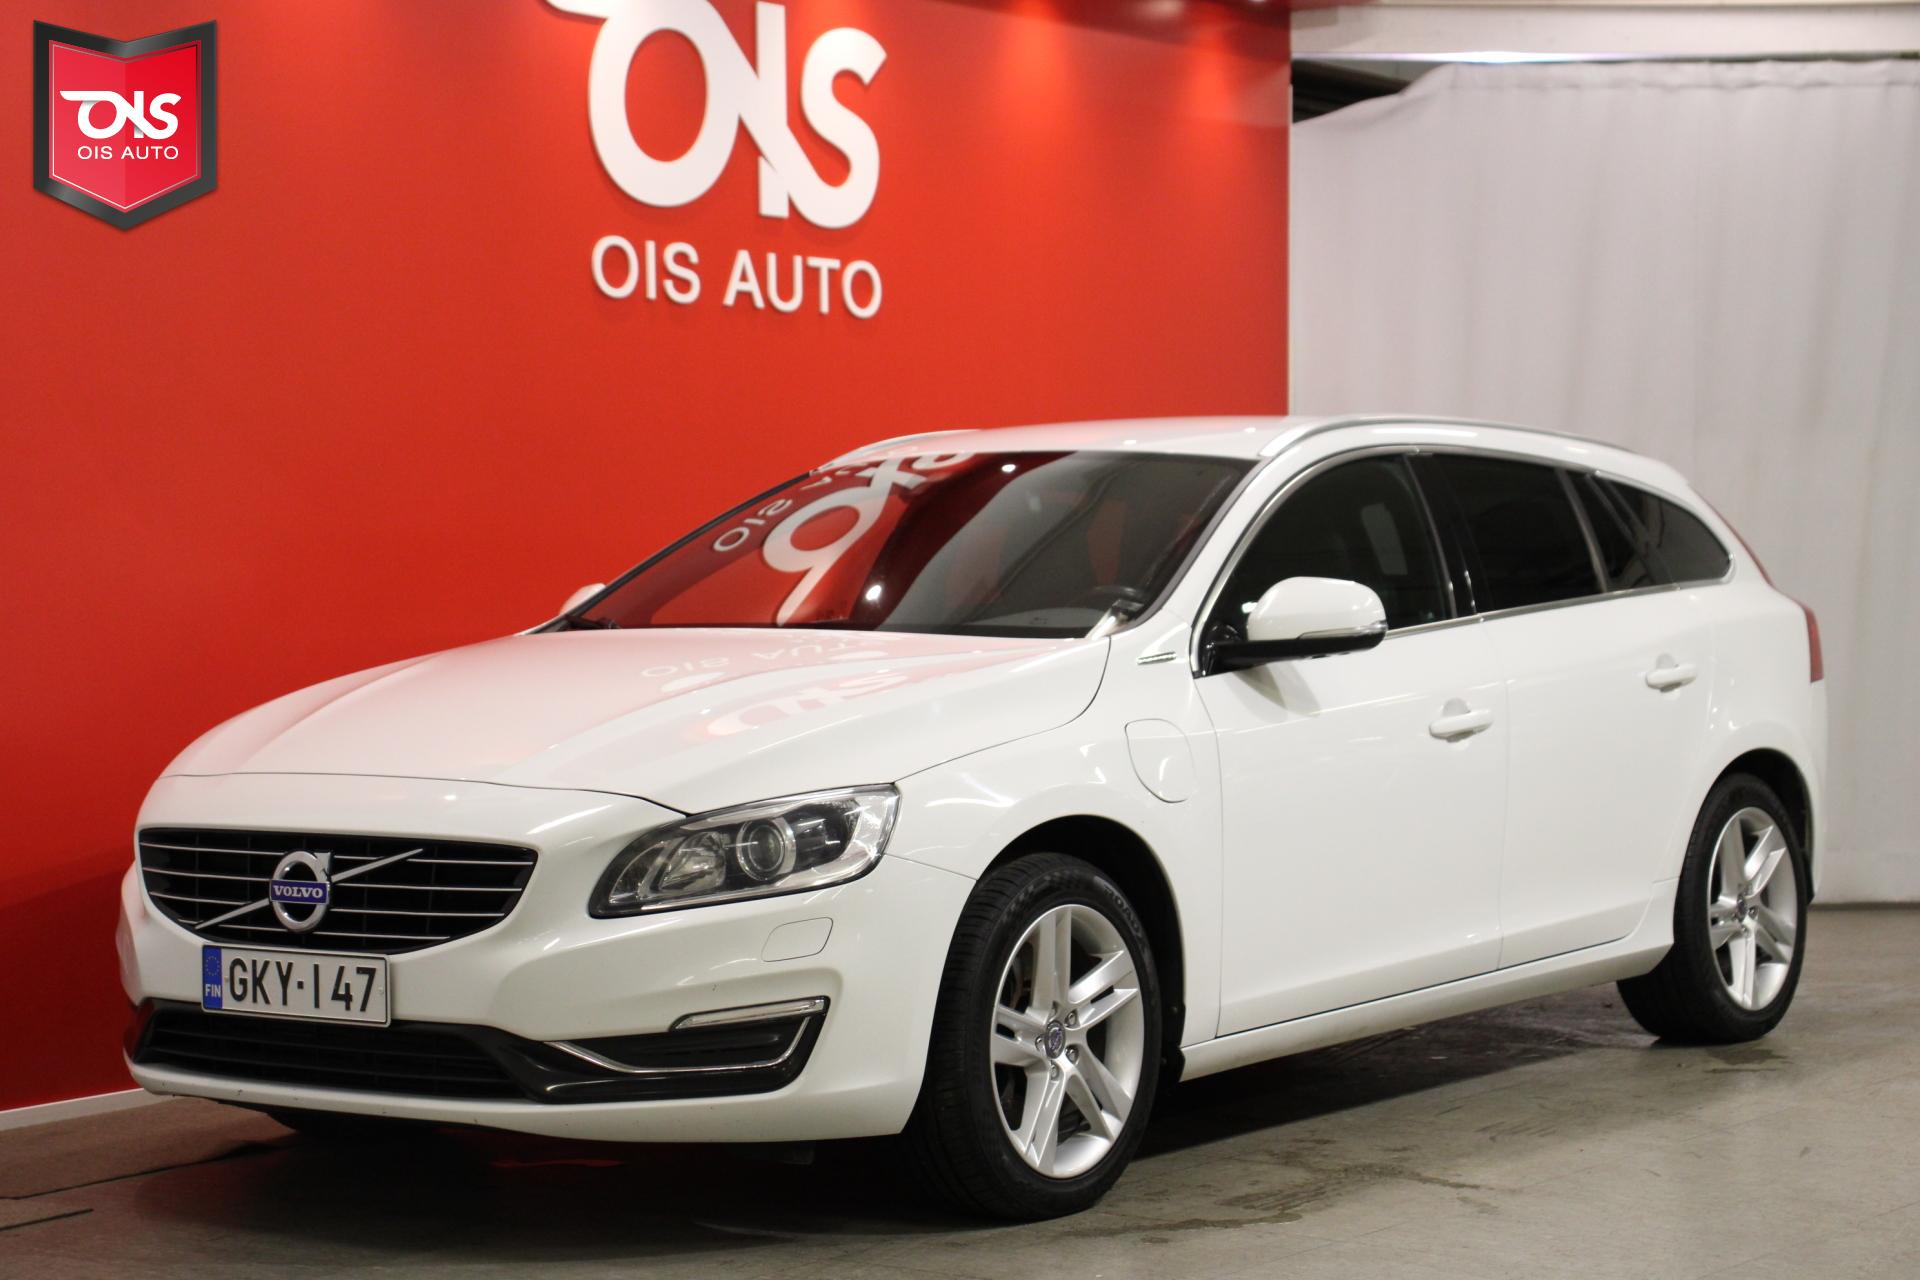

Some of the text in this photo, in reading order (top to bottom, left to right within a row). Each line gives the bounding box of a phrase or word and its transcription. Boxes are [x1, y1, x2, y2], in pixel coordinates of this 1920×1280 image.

[545, 0, 888, 229] OIS
[591, 235, 883, 320] OIS AUTO
[273, 884, 324, 899] VOLVO
[204, 983, 222, 998] FIN
[229, 957, 378, 1013] GKY-147
